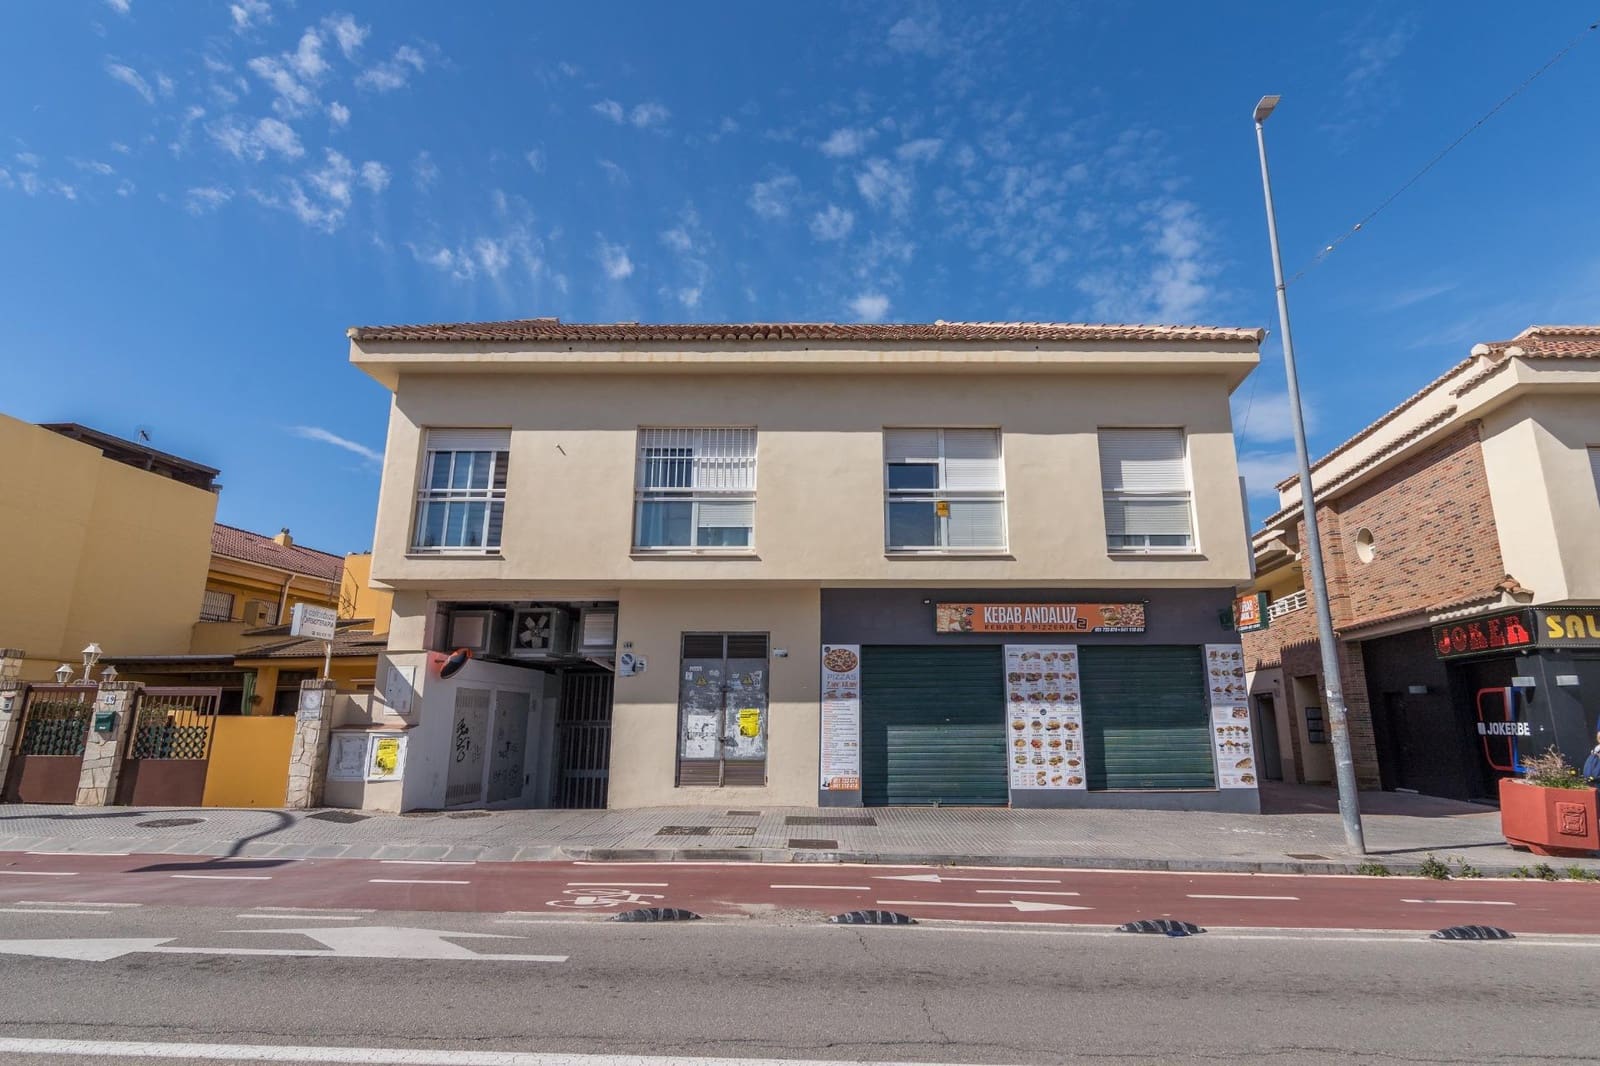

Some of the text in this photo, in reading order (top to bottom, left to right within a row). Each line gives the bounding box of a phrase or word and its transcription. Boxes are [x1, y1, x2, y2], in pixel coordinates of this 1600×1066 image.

[984, 606, 1087, 630] KEBAB ANDALUZ 2
[1438, 616, 1530, 653] JOKER
[827, 673, 857, 681] PIZZAS
